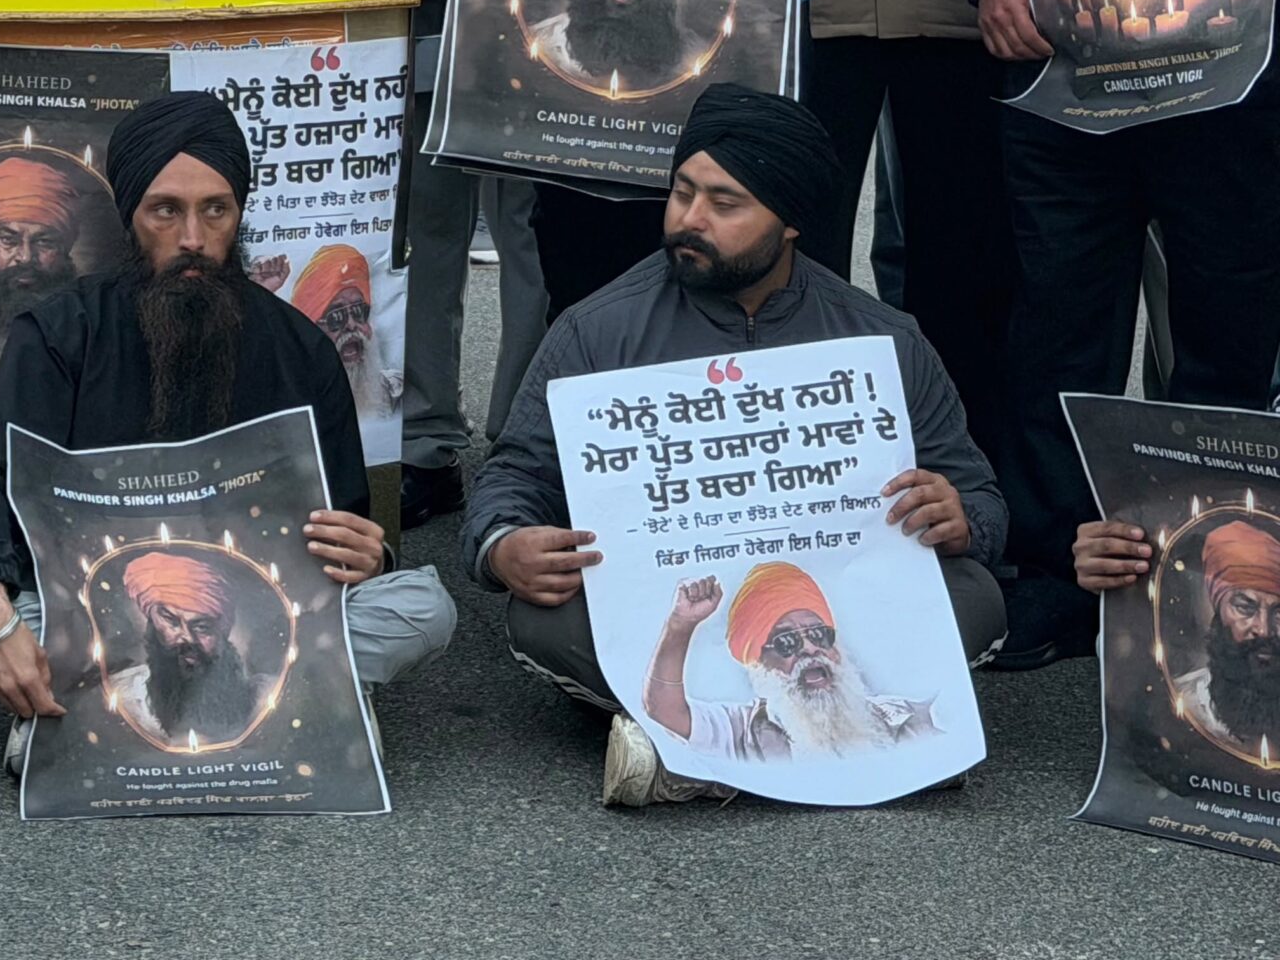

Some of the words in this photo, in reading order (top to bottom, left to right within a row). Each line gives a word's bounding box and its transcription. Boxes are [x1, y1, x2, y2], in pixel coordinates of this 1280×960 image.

[1138, 58, 1169, 69] SINGH
[1171, 54, 1210, 65] KHALSA
[1104, 73, 1174, 93] CANDLELIGHT
[1176, 69, 1204, 84] VIGIL
[37, 96, 87, 108] KHALSA
[248, 117, 288, 156] ਪੁੱਤ
[294, 112, 367, 147] ਹਜ਼ਾਰਾਂ
[536, 110, 597, 128] CANDLE
[601, 116, 646, 133] LIGHT
[651, 122, 683, 136] VIGI
[542, 133, 554, 142] He
[556, 133, 584, 146] fought
[586, 138, 617, 151] against
[619, 140, 634, 150] the
[636, 143, 656, 155] drug
[285, 159, 334, 184] ਬਚਾ
[665, 386, 726, 424] ਕੋਈ
[733, 382, 785, 423] ਦੁੱਖ
[792, 368, 855, 409] ਨਹੀਂ
[581, 442, 639, 475] ਮੇਰਾ
[646, 430, 695, 472] ਪੁੱਤ
[700, 420, 790, 462] ਹਜ਼ਾਰਾਂ
[797, 412, 865, 449] ਮਾਵਾਂ
[872, 407, 899, 442] ਦੇ
[1196, 435, 1280, 460] SHAHEED
[1133, 443, 1202, 465] PARVINDER
[1203, 456, 1245, 471] SINGH
[1246, 463, 1280, 478] KHAL
[118, 470, 200, 490] SHAHEED
[643, 471, 691, 513] ਪੁੱਤ
[696, 469, 757, 500] ਬਚਾ
[53, 486, 121, 506] PARVINDER
[123, 495, 163, 506] SINGH
[167, 485, 217, 505] KHALSA
[116, 766, 181, 777] CANDLE
[187, 763, 234, 775] LIGHT
[241, 760, 284, 773] VIGIL
[142, 783, 173, 791] fought
[175, 781, 209, 790] against
[211, 780, 226, 788] the
[229, 779, 250, 788] drug
[1189, 775, 1251, 797] CANDLE
[1195, 801, 1209, 812] He
[1210, 803, 1241, 818] fought
[1241, 811, 1275, 825] against
